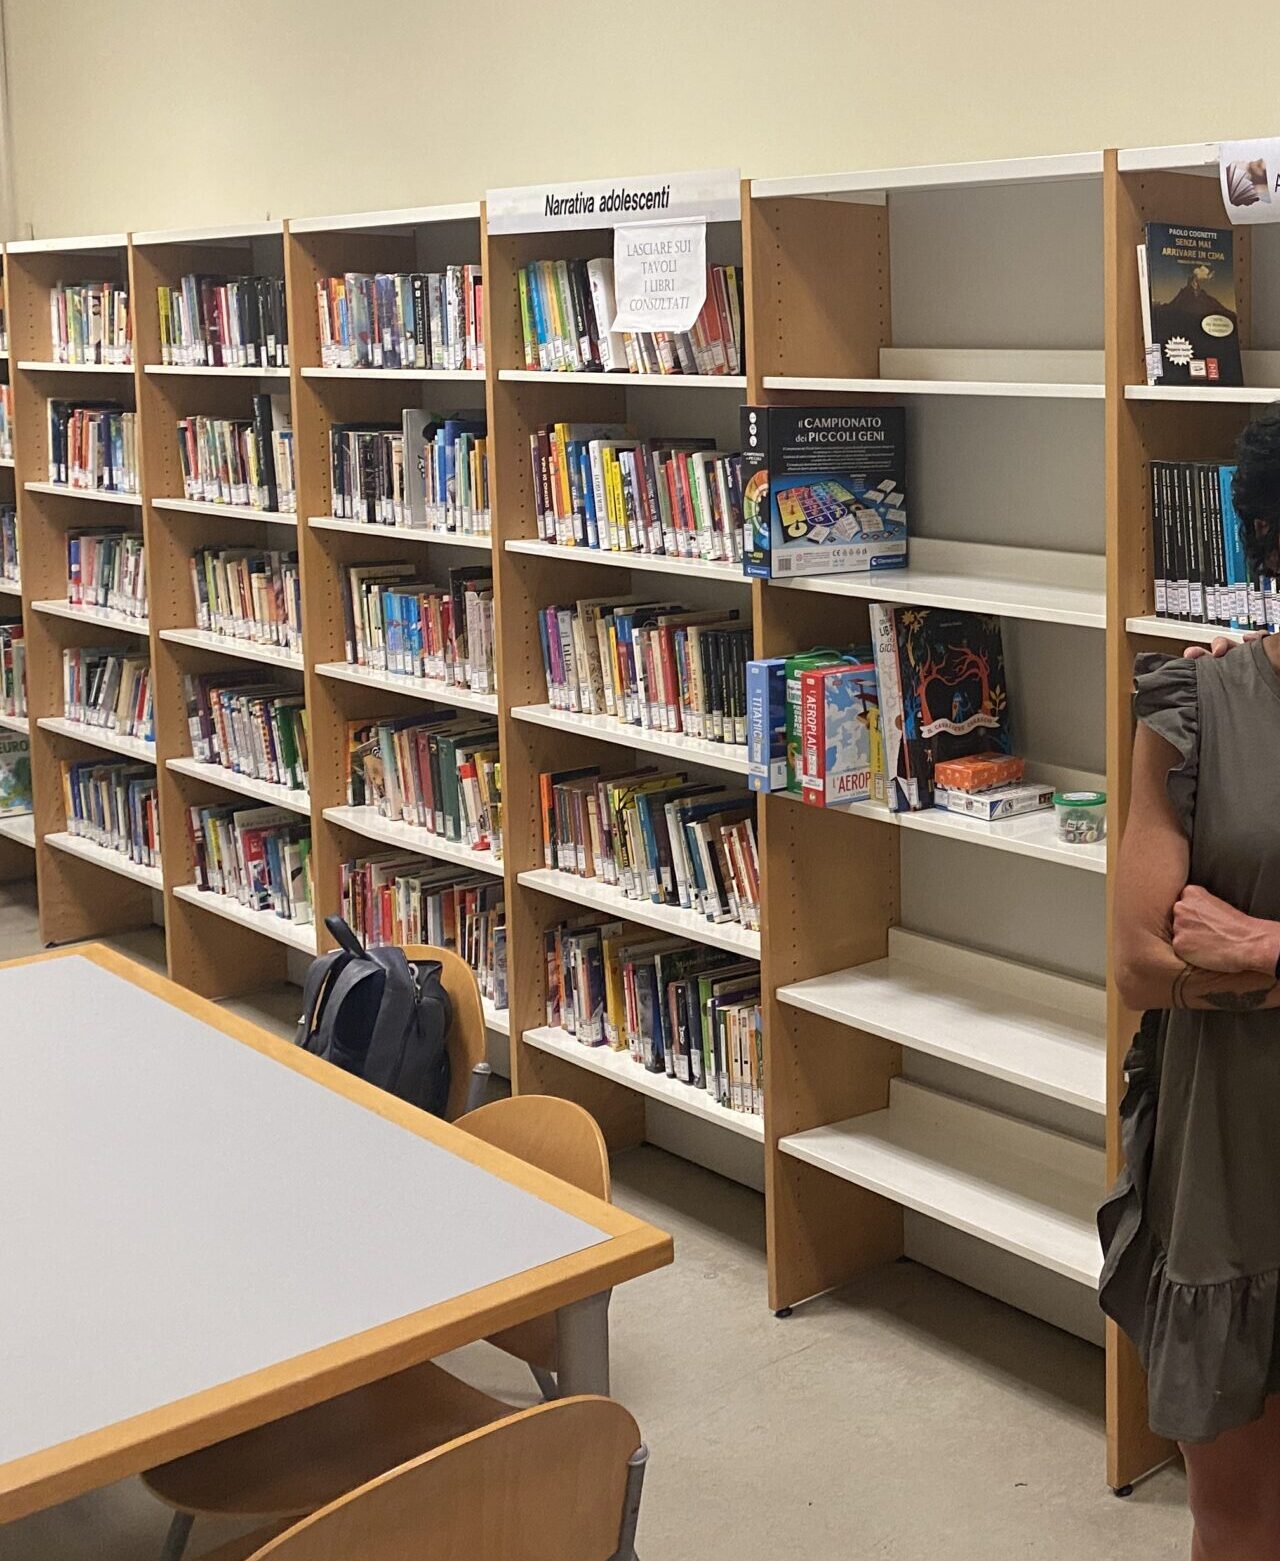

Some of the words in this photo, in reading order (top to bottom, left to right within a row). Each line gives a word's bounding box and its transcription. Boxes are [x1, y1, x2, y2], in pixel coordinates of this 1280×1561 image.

[545, 192, 595, 217] Narrativa
[600, 185, 670, 213] adolescenti
[1168, 228, 1188, 237] PAOLO
[1189, 231, 1217, 239] COGNETTI
[627, 241, 672, 256] LASCIARE
[674, 240, 691, 254] SUI
[1175, 239, 1197, 247] SENZA
[1199, 240, 1212, 248] MAI
[1162, 247, 1197, 258] ARRIVARE
[1198, 250, 1206, 258] IN
[1207, 252, 1225, 260] CIMA
[641, 260, 677, 274] TAVOLI
[650, 279, 675, 292] LIBRI
[629, 297, 690, 311] CONSULTATI
[804, 417, 881, 428] CAMPIONATO
[808, 431, 856, 442] PICCOLI
[858, 431, 885, 442] GENI
[753, 698, 763, 738] TITANIC
[832, 772, 871, 793] L'AEROP
